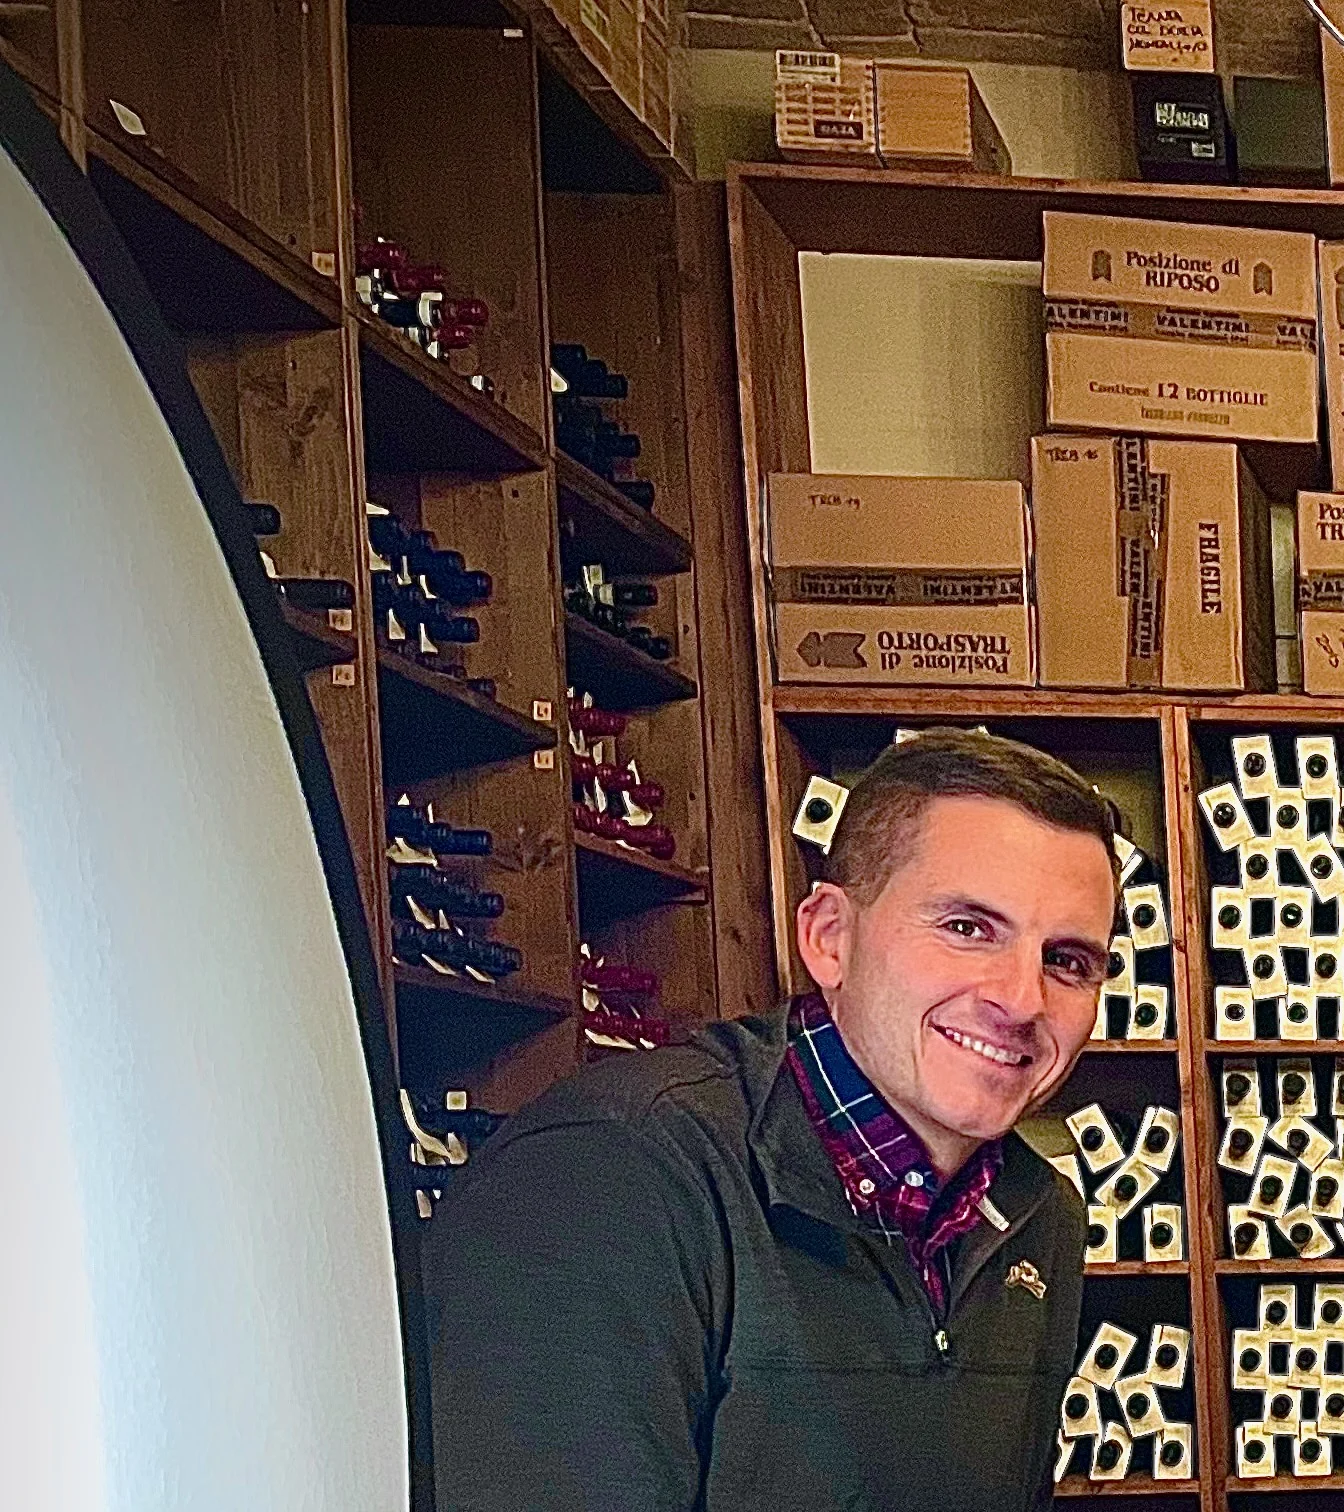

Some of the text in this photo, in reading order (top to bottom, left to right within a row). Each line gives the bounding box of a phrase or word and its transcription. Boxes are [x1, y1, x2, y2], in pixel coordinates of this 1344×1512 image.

[1126, 250, 1241, 277] Posizione di
[1145, 270, 1220, 294] RIPOSO
[1046, 304, 1129, 323] ALENTINI
[1155, 313, 1250, 334] VALENTINI
[1157, 382, 1180, 400] 12
[1198, 522, 1222, 615] FRAGILE
[877, 630, 1012, 656] TRASPORTO
[880, 651, 1009, 674] Posizione di
